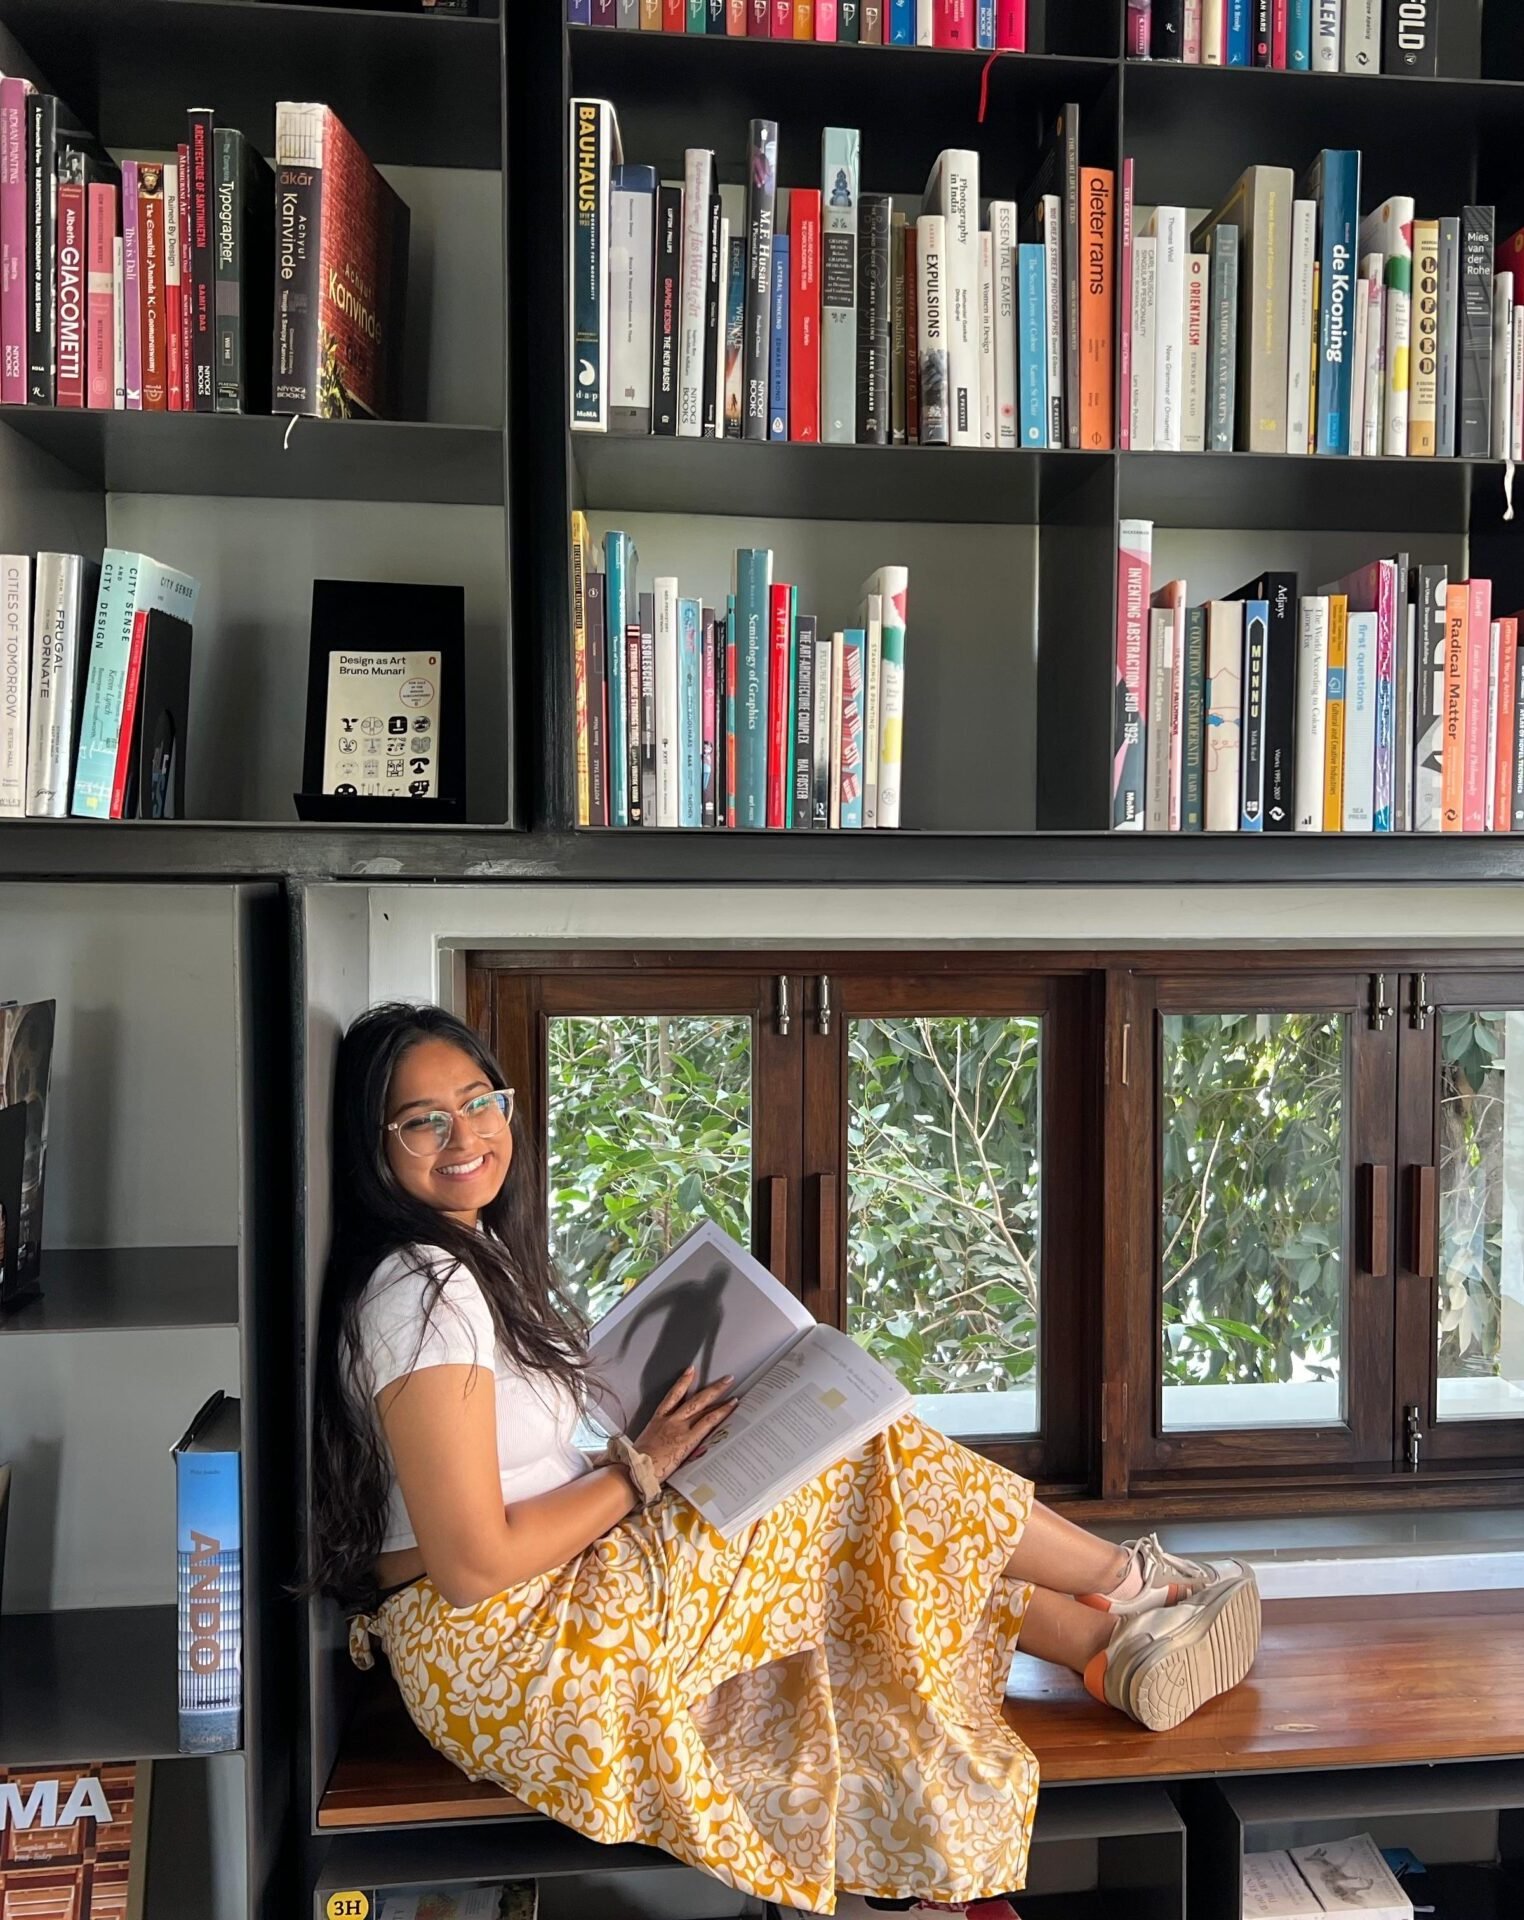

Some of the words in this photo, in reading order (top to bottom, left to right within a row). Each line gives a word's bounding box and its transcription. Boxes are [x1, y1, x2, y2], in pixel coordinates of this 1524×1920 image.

[1398, 0, 1426, 50] OLD
[9, 108, 18, 141] INDIAN
[8, 142, 18, 184] PAINTING
[195, 124, 204, 180] ARCHITECTURE
[579, 106, 595, 212] BAUHAUS
[196, 182, 205, 192] OF
[950, 174, 959, 184] in
[146, 203, 154, 217] The
[167, 195, 176, 225] Ruined
[711, 205, 719, 213] The
[950, 186, 960, 214] India
[956, 178, 968, 245] Photography
[1089, 178, 1109, 237] dieter
[65, 208, 76, 245] Alberto
[167, 226, 177, 237] By
[196, 194, 205, 248] SANTINIKETAN
[219, 181, 235, 263] Typographer
[280, 192, 298, 280] Kanvinde
[711, 214, 719, 245] Emergence
[759, 210, 771, 239] M.F.
[1050, 220, 1058, 245] GREAT
[1467, 232, 1489, 242] Mies
[126, 227, 136, 248] This
[146, 219, 155, 257] Essential
[167, 238, 178, 267] Design
[297, 215, 307, 260] Achyut
[999, 208, 1010, 271] ESSENTIAL
[1467, 245, 1484, 253] van
[757, 243, 770, 293] Husain
[1050, 247, 1058, 276] STREET
[1088, 243, 1104, 295] rams
[1332, 244, 1350, 271] de
[1467, 254, 1483, 264] der
[1467, 265, 1491, 275] Rohe
[146, 260, 155, 294] Ananda
[664, 278, 673, 308] GRAPHIC
[894, 276, 904, 295] This
[199, 284, 207, 311] SAMIT
[328, 268, 383, 343] Kanvinde
[894, 296, 903, 304] is
[926, 253, 939, 338] EXPULSIONS
[982, 282, 991, 313] Women
[1000, 276, 1011, 317] EAMES
[1050, 278, 1059, 335] PHOTOGRAPHS
[60, 247, 80, 379] GIACOMETTI
[199, 314, 207, 332] DAS
[663, 308, 672, 334] DESIGN
[734, 305, 744, 350] WRINKLE
[775, 294, 783, 330] THINKING
[982, 315, 990, 323] in
[1188, 281, 1201, 346] ORIENTALISM
[1219, 301, 1229, 345] BAMBOO
[1327, 275, 1350, 363] Kooning
[1421, 257, 1437, 375] LIFTED
[146, 310, 157, 374] Coomaraswamy
[662, 336, 671, 349] THE
[893, 306, 904, 356] Kandinsky
[982, 326, 991, 354] Design
[662, 350, 671, 365] NEW
[774, 338, 782, 367] EDWARD
[1166, 345, 1174, 361] New
[1190, 351, 1198, 385] EDWARD
[661, 367, 671, 392] BASICS
[774, 370, 782, 379] DE
[1165, 362, 1173, 395] Grammar
[1218, 356, 1228, 382] CANE
[681, 387, 690, 424] BOOKS
[689, 387, 697, 424] NIYOGI
[748, 379, 757, 417] BOOKS
[756, 380, 765, 418] NIYOGI
[774, 381, 782, 401] BONO
[1217, 386, 1227, 424] CRAFTS
[8, 568, 19, 610] CITIES
[102, 564, 114, 593] CITY
[127, 567, 139, 597] CITY
[160, 576, 174, 589] CITY
[174, 580, 193, 599] SENSE
[1127, 567, 1142, 619] INVENTING
[1276, 585, 1288, 619] Adjaye
[1314, 608, 1323, 625] The
[8, 613, 19, 631] OF
[95, 602, 109, 650] DESIGN
[121, 602, 135, 643] SENSE
[776, 607, 786, 650] APPLE
[1302, 606, 1313, 632] James
[53, 609, 65, 674] FRUGAL
[745, 613, 759, 668] Semiology
[799, 630, 811, 648] THE
[1188, 626, 1201, 677] CONDITION
[1303, 633, 1312, 649] Fox
[1313, 626, 1322, 652] World
[1358, 623, 1368, 650] first
[1450, 617, 1462, 680] Radical
[39, 634, 51, 698] ORNATE
[339, 656, 374, 667] Design
[389, 656, 406, 665] Art
[339, 666, 369, 675] Bruno
[371, 666, 406, 675] Munari
[642, 633, 653, 697] OBSOLESCENCE
[869, 643, 877, 683] STAMPING
[1126, 621, 1141, 688] ABSTRACTION
[6, 636, 18, 719] TOMORROW
[107, 669, 117, 690] Kevin
[746, 670, 759, 681] of
[798, 649, 811, 711] ART-ARCHITECTURE
[1251, 645, 1261, 718] MUNNU
[1310, 654, 1322, 696] According
[1355, 652, 1367, 712] questions
[103, 692, 114, 716] Lynch
[745, 683, 759, 730] Graphics
[868, 692, 876, 730] PRINTING
[1331, 703, 1339, 726] Cultural
[1447, 683, 1461, 740] Matter
[797, 712, 810, 744] COMPLEX
[1187, 689, 1201, 768] POSTMODERNITY
[1311, 707, 1320, 735] Colour
[1330, 727, 1339, 739] and
[797, 759, 809, 773] HAL
[1273, 749, 1281, 768] Works
[1329, 740, 1338, 764] Creative
[796, 773, 809, 800] FOSTER
[1186, 773, 1197, 803] HARVEY
[1328, 765, 1338, 796] Industries
[1126, 792, 1134, 821] MoMA
[190, 1530, 220, 1675] ANDO
[334, 1900, 361, 1916] 3H
